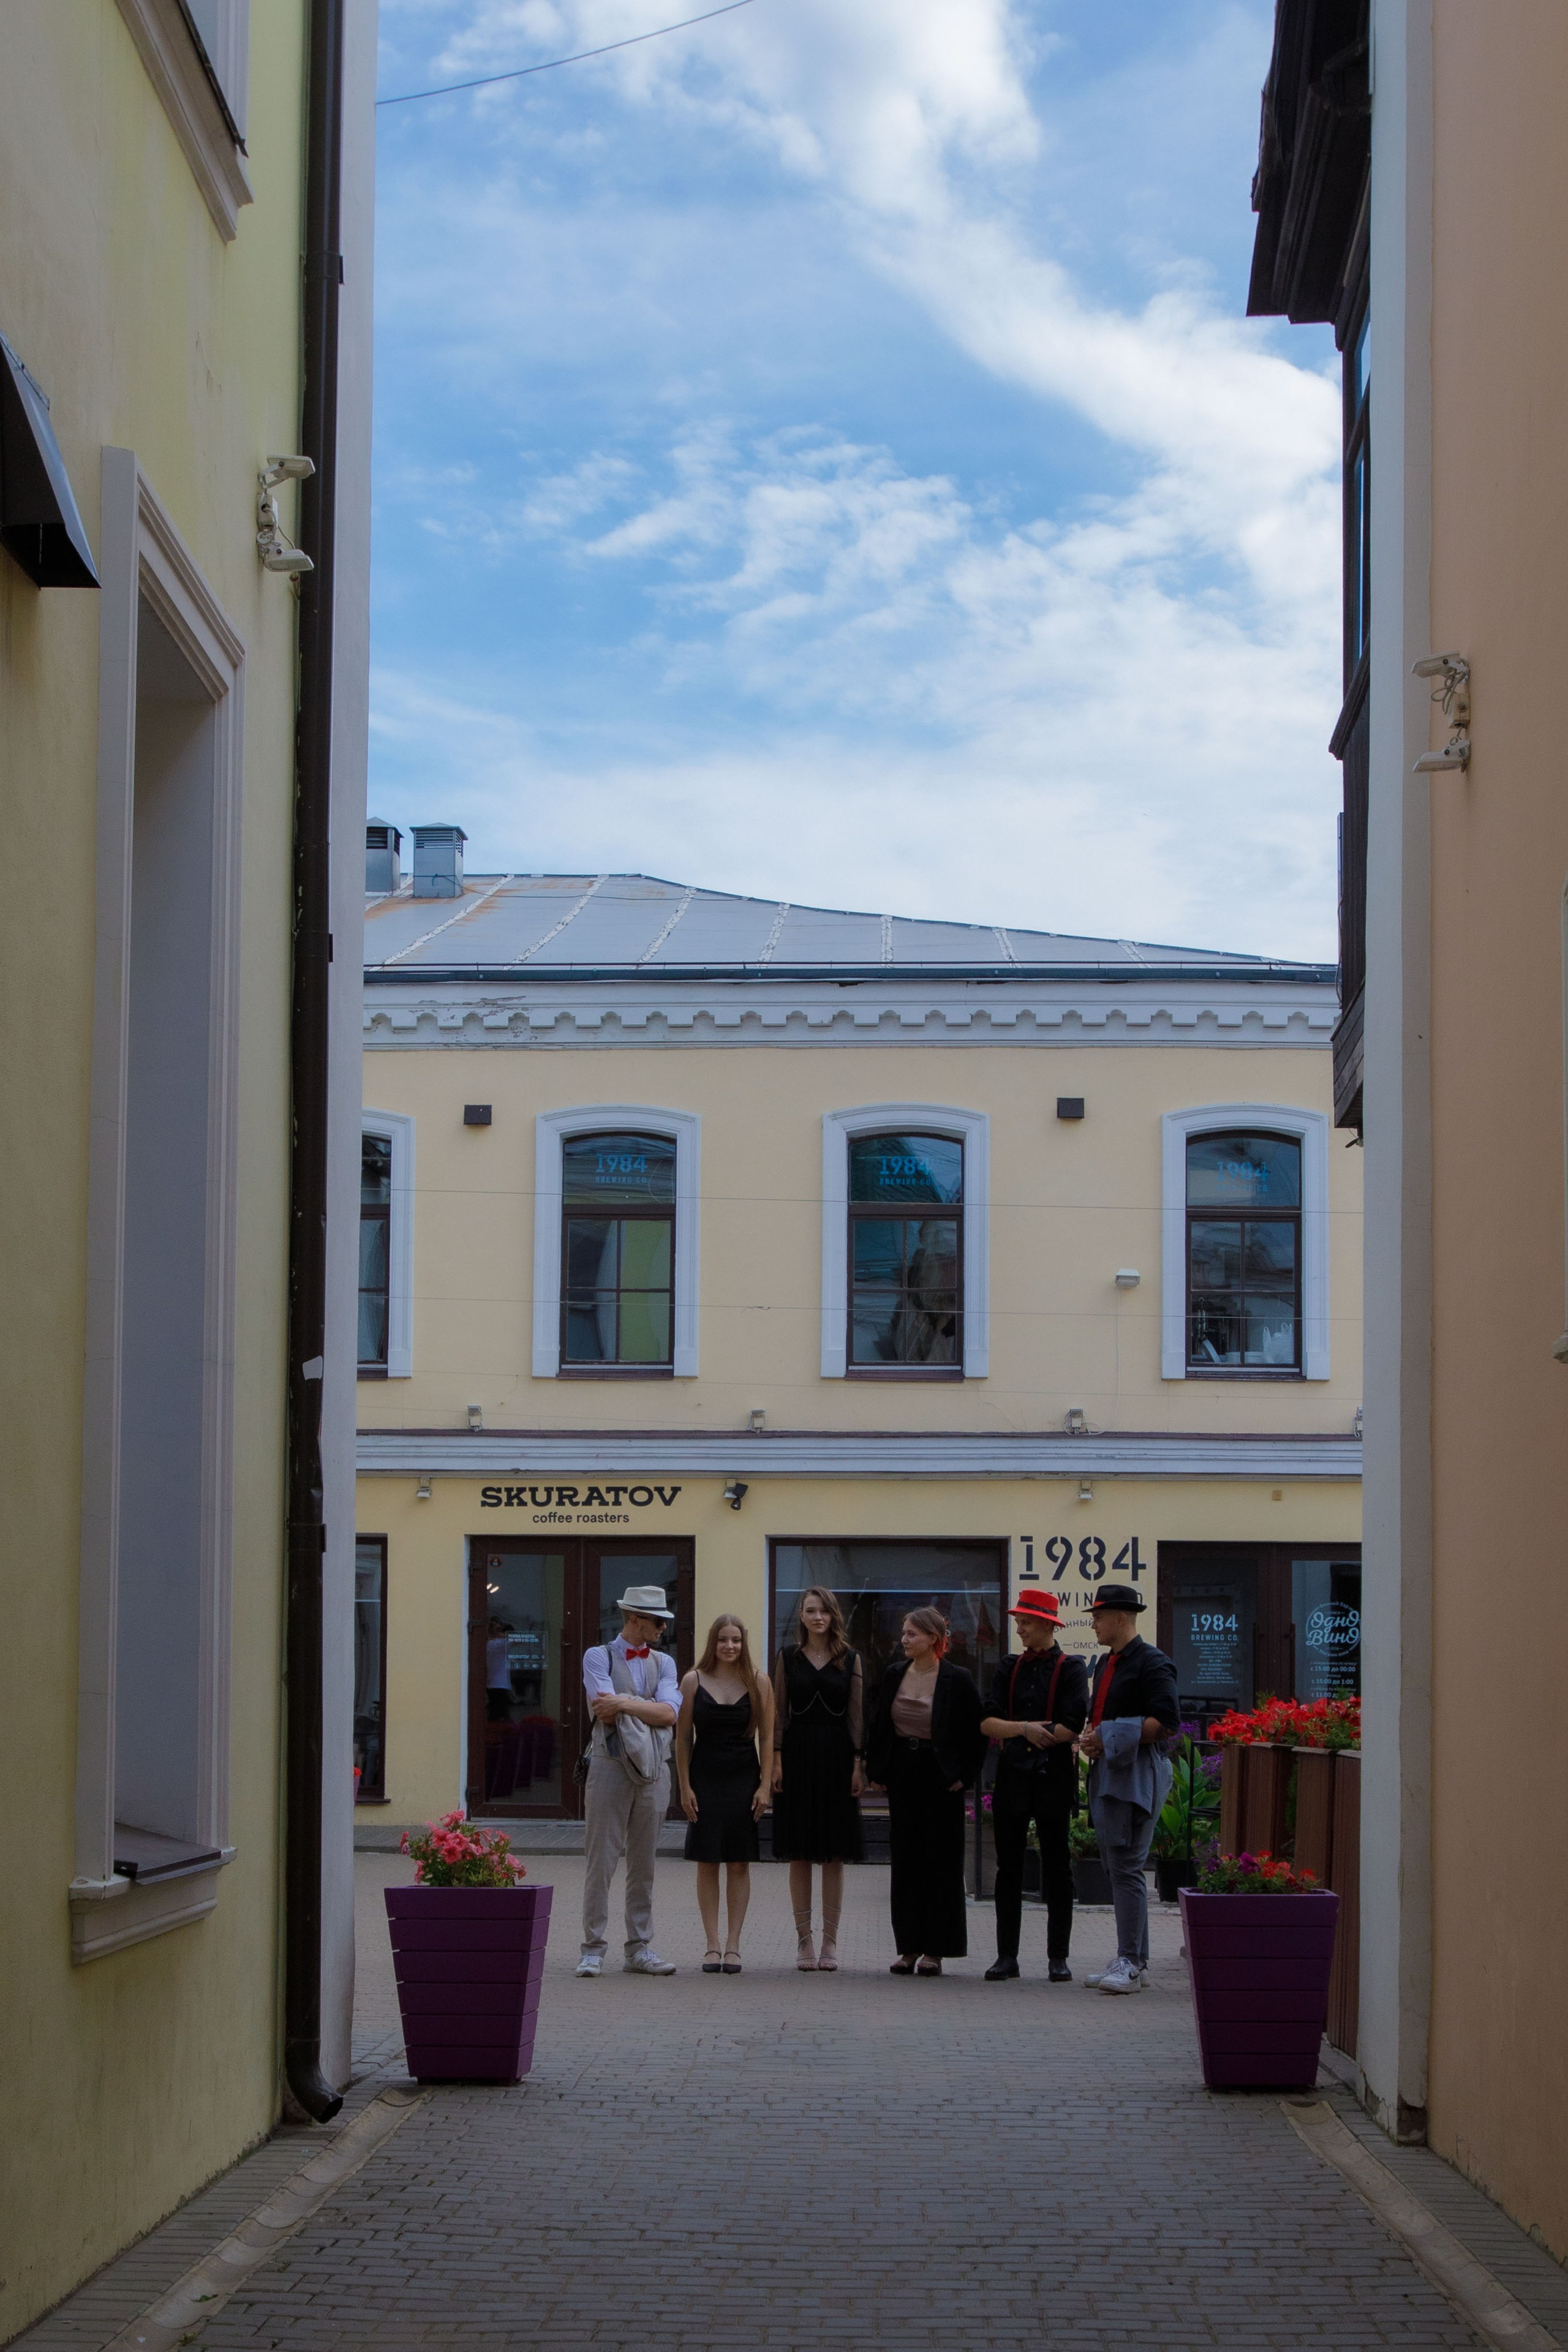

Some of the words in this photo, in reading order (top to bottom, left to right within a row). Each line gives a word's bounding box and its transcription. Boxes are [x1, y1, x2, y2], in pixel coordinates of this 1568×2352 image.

[597, 1153, 648, 1173] 1984
[880, 1156, 930, 1175] 1984
[1216, 1161, 1269, 1182] 1984
[481, 1486, 682, 1507] SKURATOV
[532, 1512, 573, 1523] coffee
[576, 1512, 630, 1523] roasters
[1019, 1536, 1147, 1581] 1984
[1191, 1613, 1238, 1631] 1984
